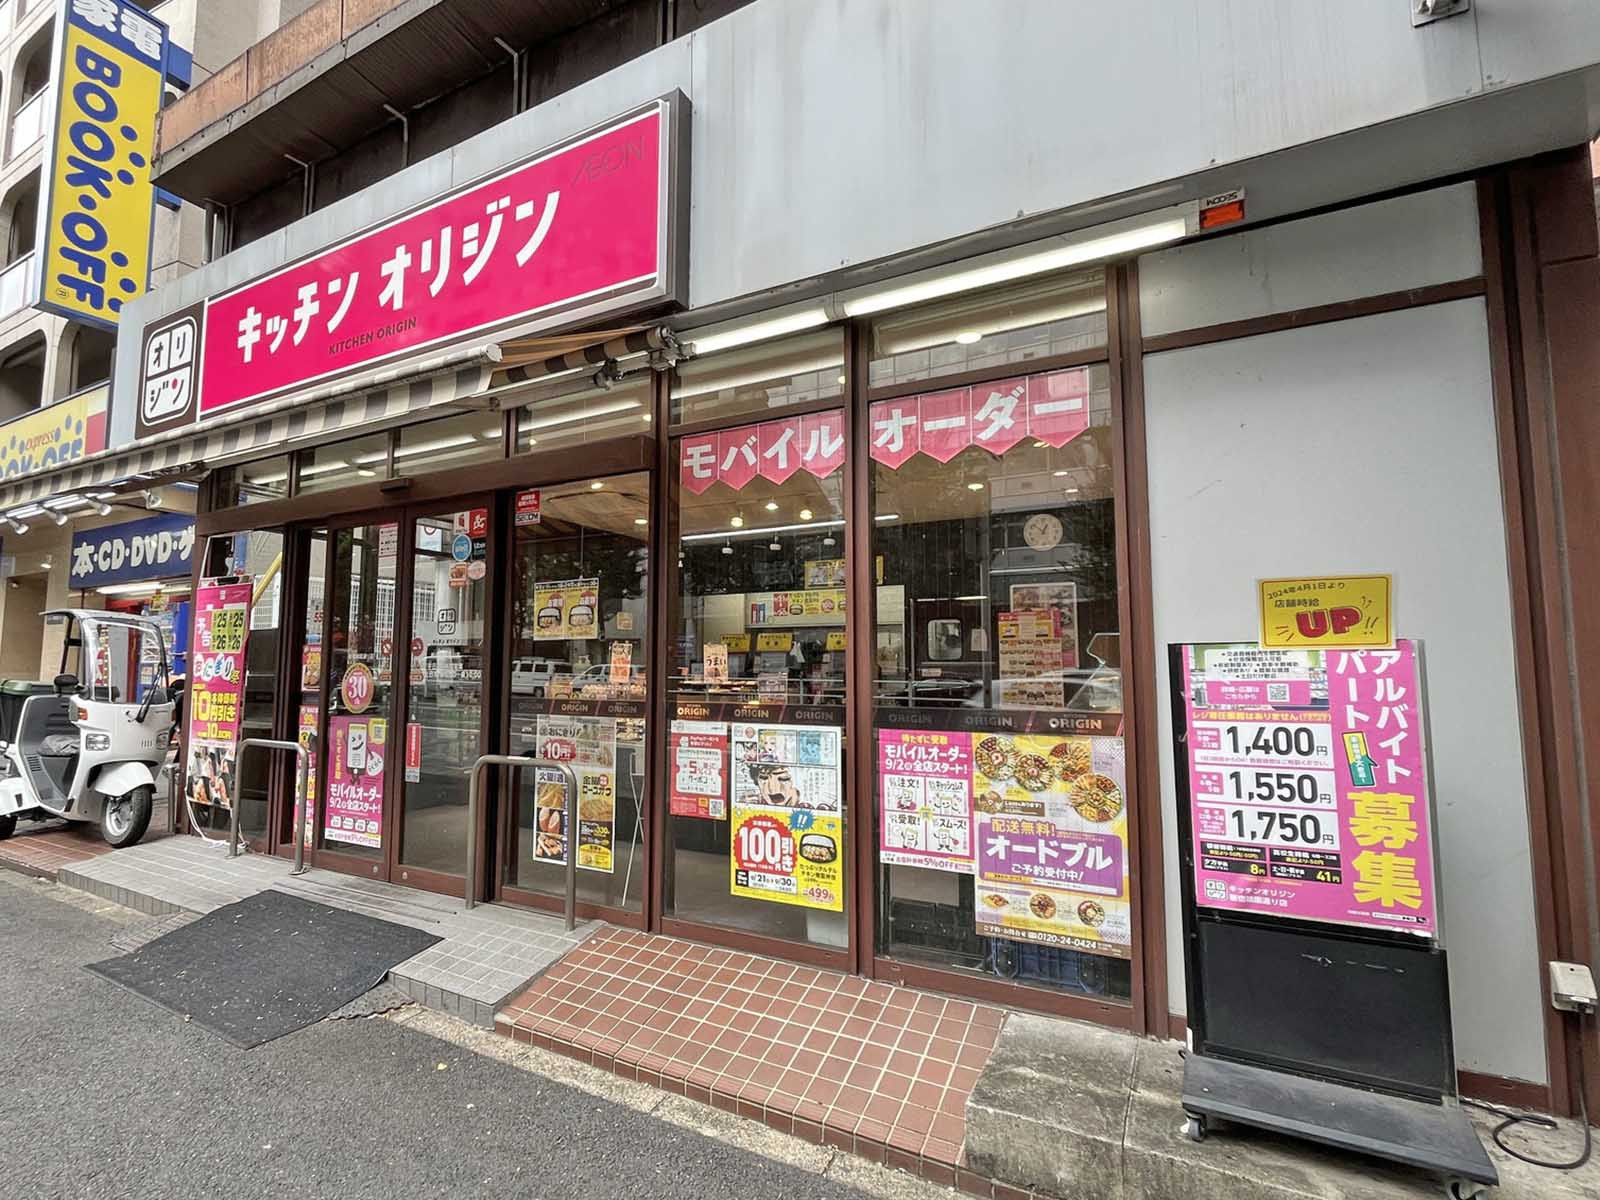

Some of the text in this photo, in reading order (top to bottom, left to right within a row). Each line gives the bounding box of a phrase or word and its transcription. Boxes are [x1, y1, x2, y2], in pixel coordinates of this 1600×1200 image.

[72, 0, 163, 61] 家電
[237, 190, 561, 364] キッチン オリジン
[328, 316, 417, 356] KITCHEN ORIGIN
[682, 385, 1083, 480] モバイル オーダー
[1267, 582, 1346, 600] 2024年4月1日より
[1274, 598, 1320, 608] 店舗時給
[217, 611, 244, 628] 25 25
[348, 675, 368, 699] 30
[1336, 650, 1371, 730] パート
[676, 706, 710, 717] ORIGIN
[734, 708, 769, 719] ORIGIN
[795, 710, 834, 721] ORIGIN
[1370, 650, 1412, 785] アルバイト
[966, 715, 1014, 728] ORIGIN
[1049, 717, 1103, 730] ORIGIN
[1226, 726, 1328, 757] 1,400円
[884, 744, 968, 762] モバイルオーダー
[329, 783, 382, 802] モバイルオーダー
[1229, 771, 1332, 804] 1,550円
[991, 818, 1056, 838] 配送無料!
[1231, 809, 1335, 846] 1,750円
[985, 835, 1113, 872] オードブル
[1346, 790, 1424, 909] 募集
[1011, 863, 1084, 882] ご予約受付中!
[1315, 870, 1340, 883] 41円
[1037, 932, 1098, 950] 0120-24-0424
